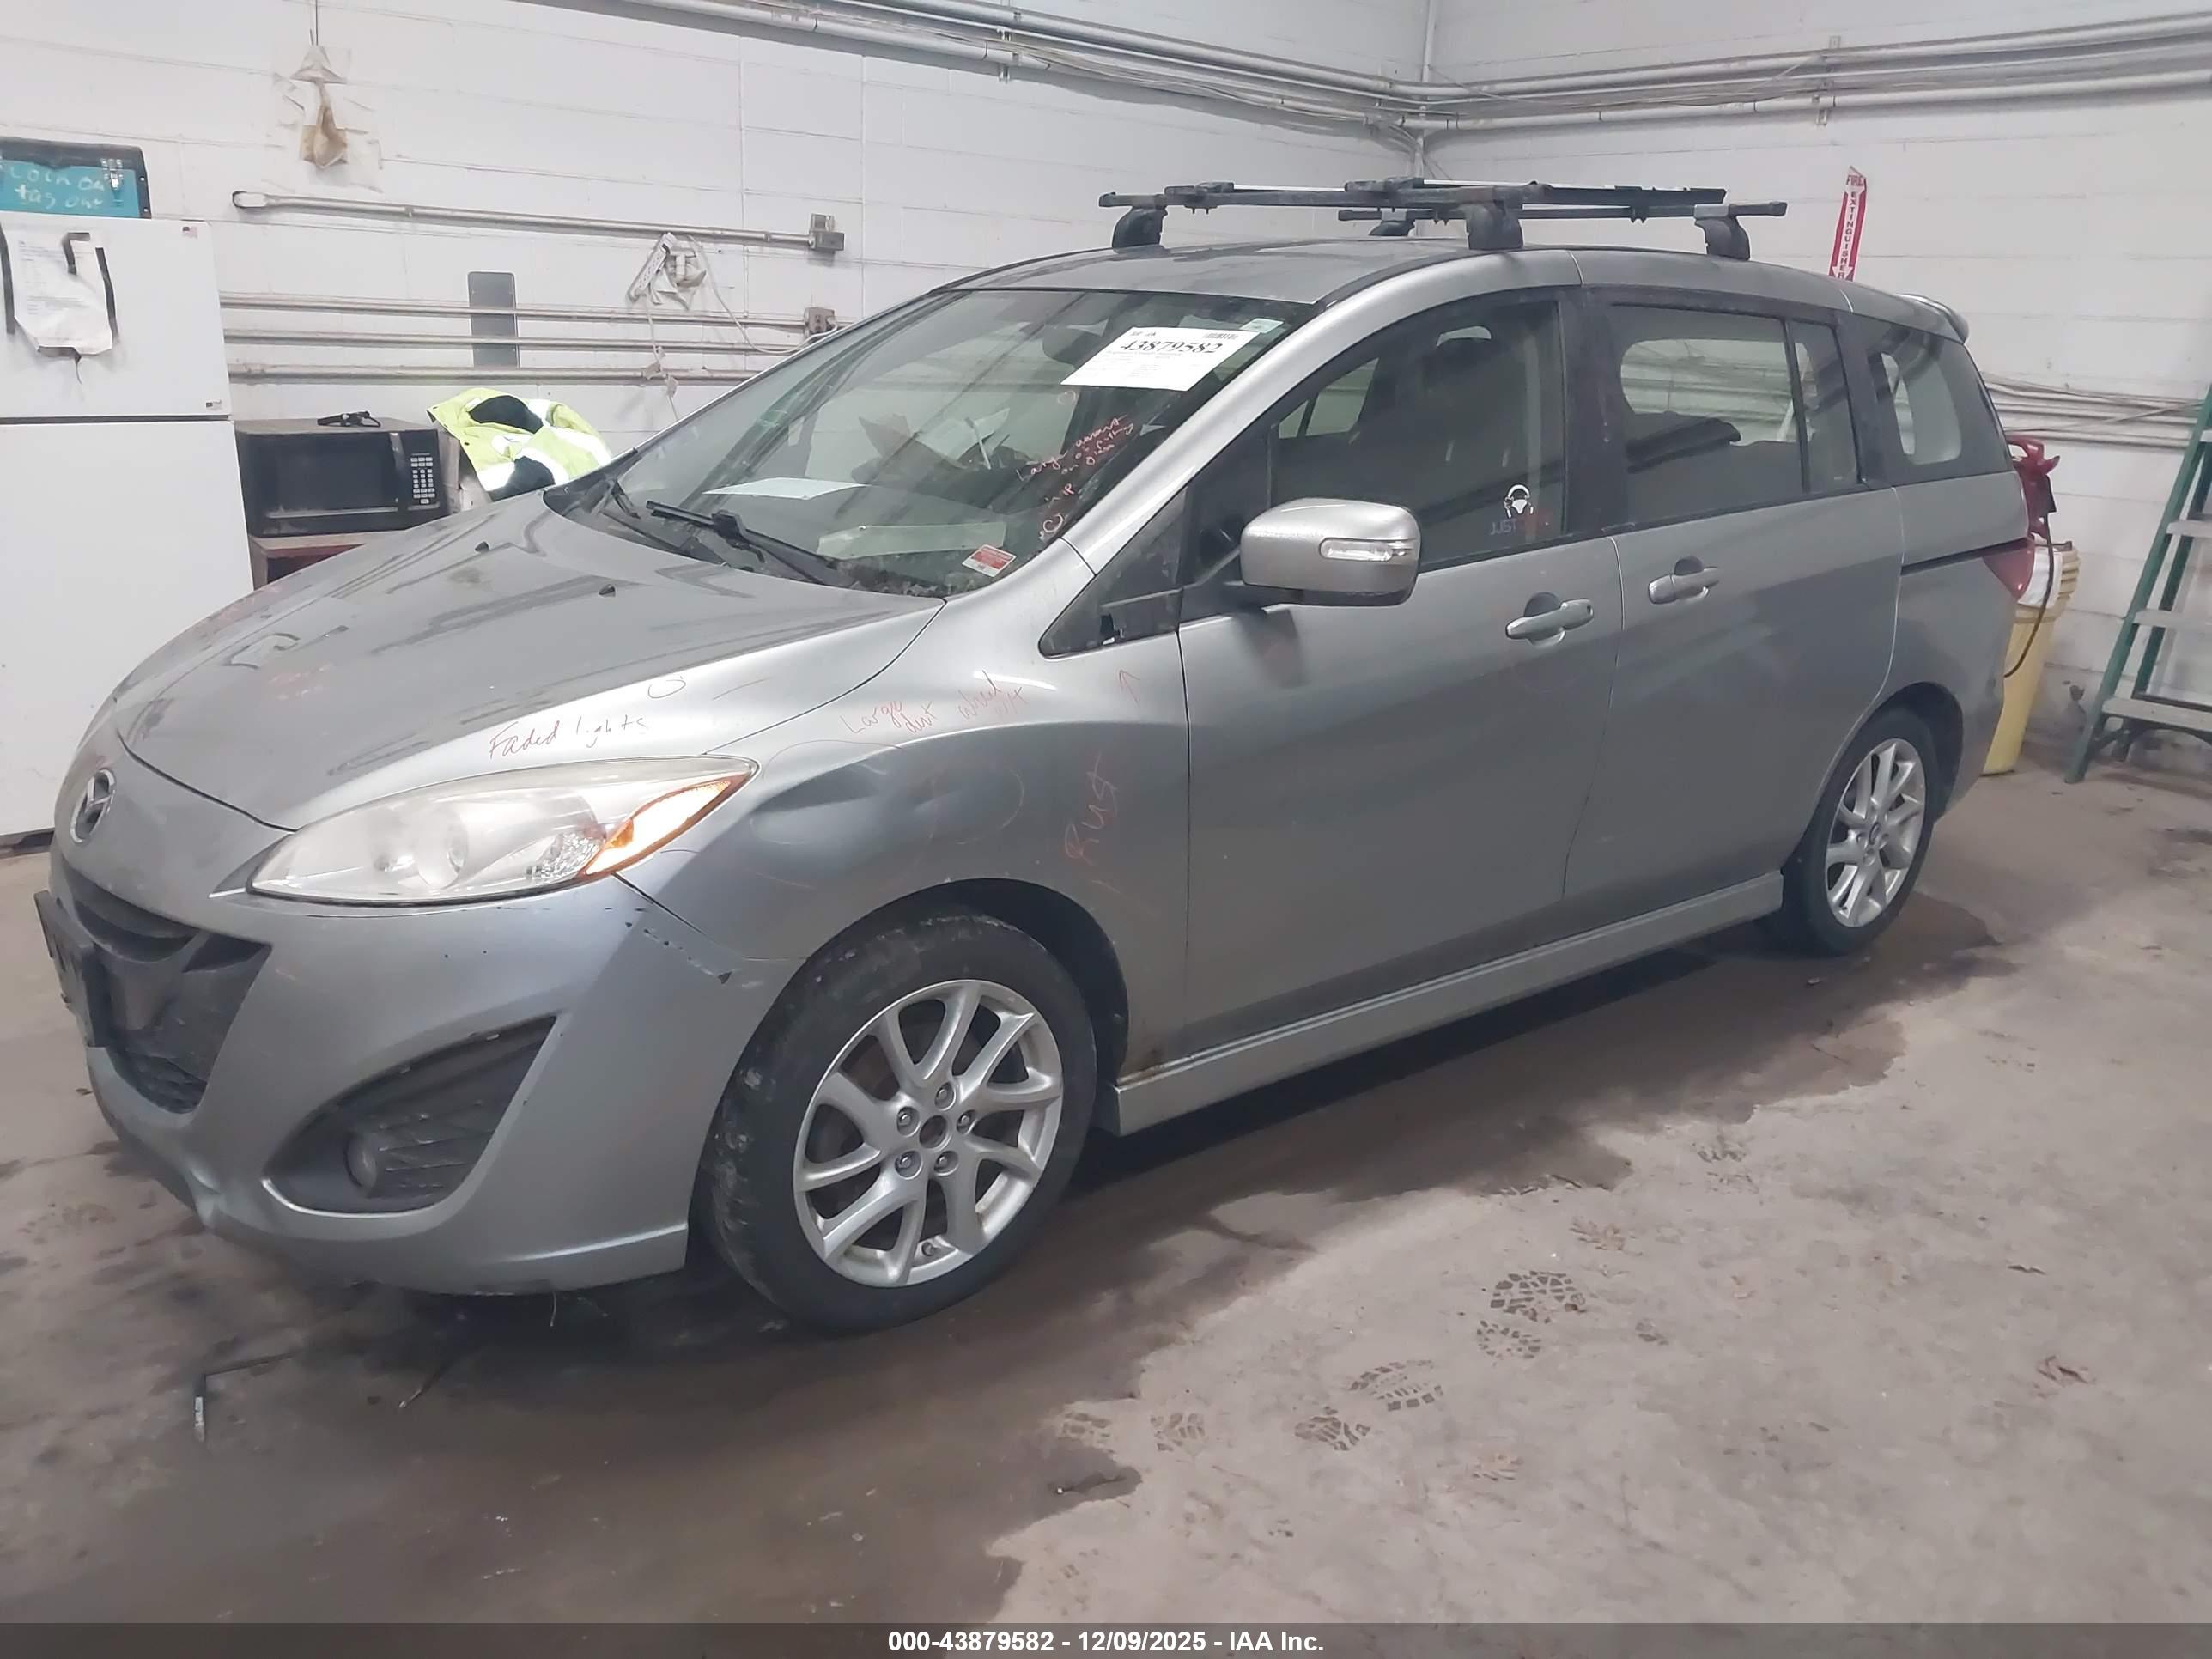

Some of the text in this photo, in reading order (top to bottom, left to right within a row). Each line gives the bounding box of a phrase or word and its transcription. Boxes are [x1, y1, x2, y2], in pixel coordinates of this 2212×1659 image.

[1845, 174, 1865, 186] FIRE
[1837, 191, 1857, 280] EXTINGUISHER
[1120, 340, 1224, 354] 43879582
[1491, 519, 1518, 536] JUST
[489, 720, 561, 760] Faded
